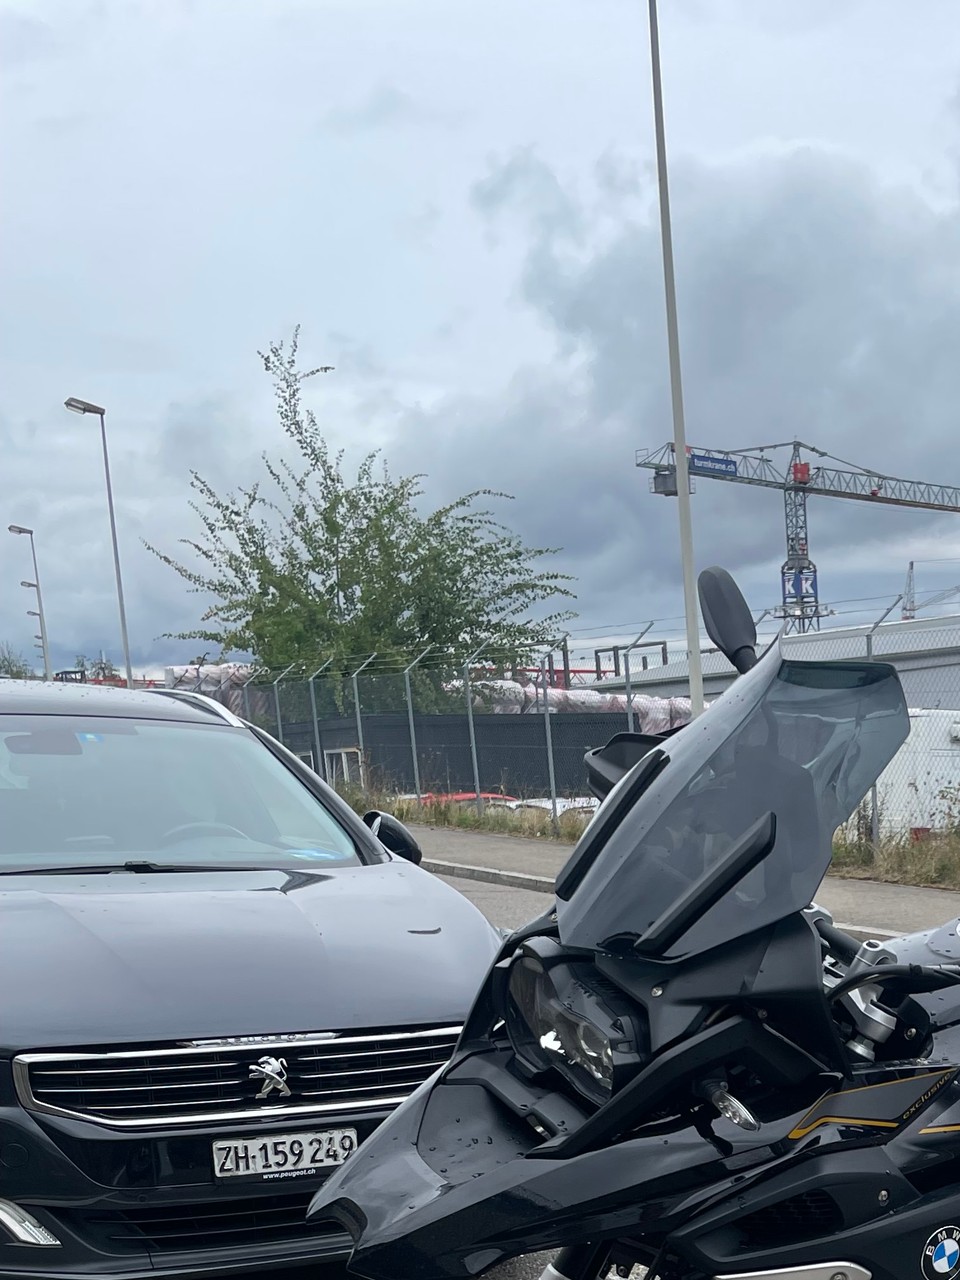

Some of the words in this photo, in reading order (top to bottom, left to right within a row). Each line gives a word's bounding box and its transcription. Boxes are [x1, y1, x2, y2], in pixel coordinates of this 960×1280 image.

[785, 580, 796, 595] K
[801, 580, 815, 594] K
[903, 1072, 951, 1119] exclusive
[262, 1168, 316, 1179] www.peugeot.ch
